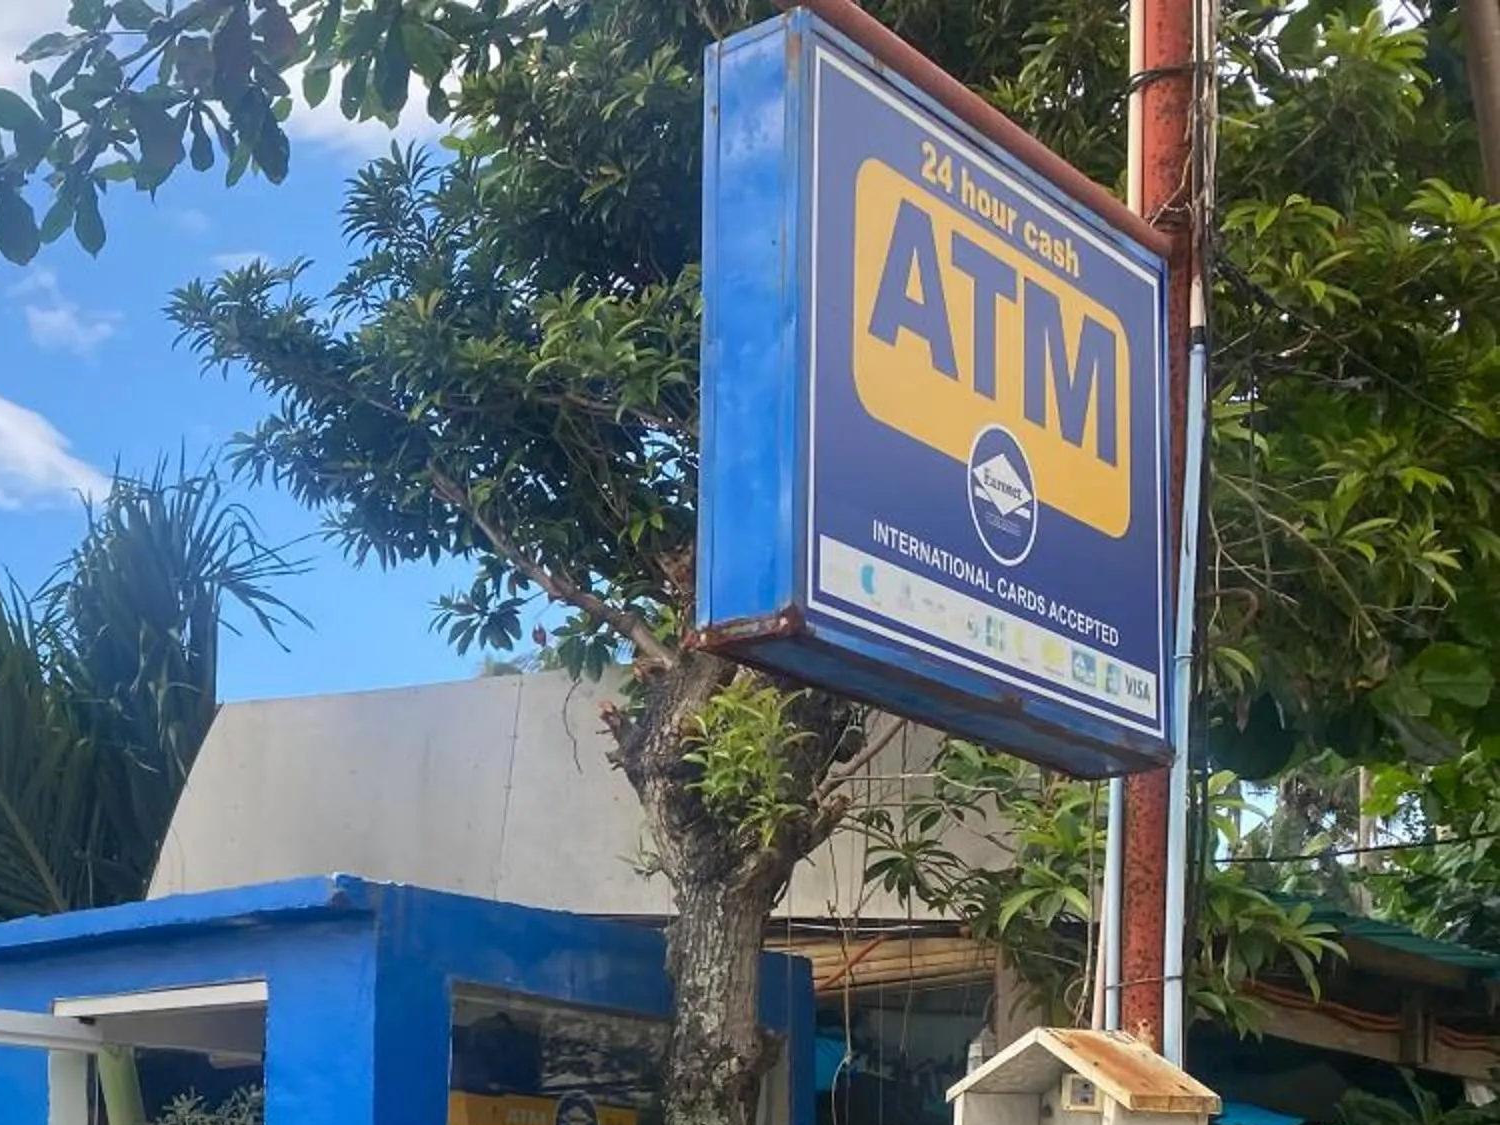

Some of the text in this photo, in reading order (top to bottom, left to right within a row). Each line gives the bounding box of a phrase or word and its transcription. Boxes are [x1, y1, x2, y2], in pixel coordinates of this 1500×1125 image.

[921, 141, 1080, 278] 24 hour cash
[868, 198, 1117, 468] ATM
[872, 519, 994, 593] INTERNATIONAL
[997, 577, 1045, 615] CARDS
[1048, 600, 1120, 647] ACCEPTED
[1125, 673, 1151, 702] VISA
